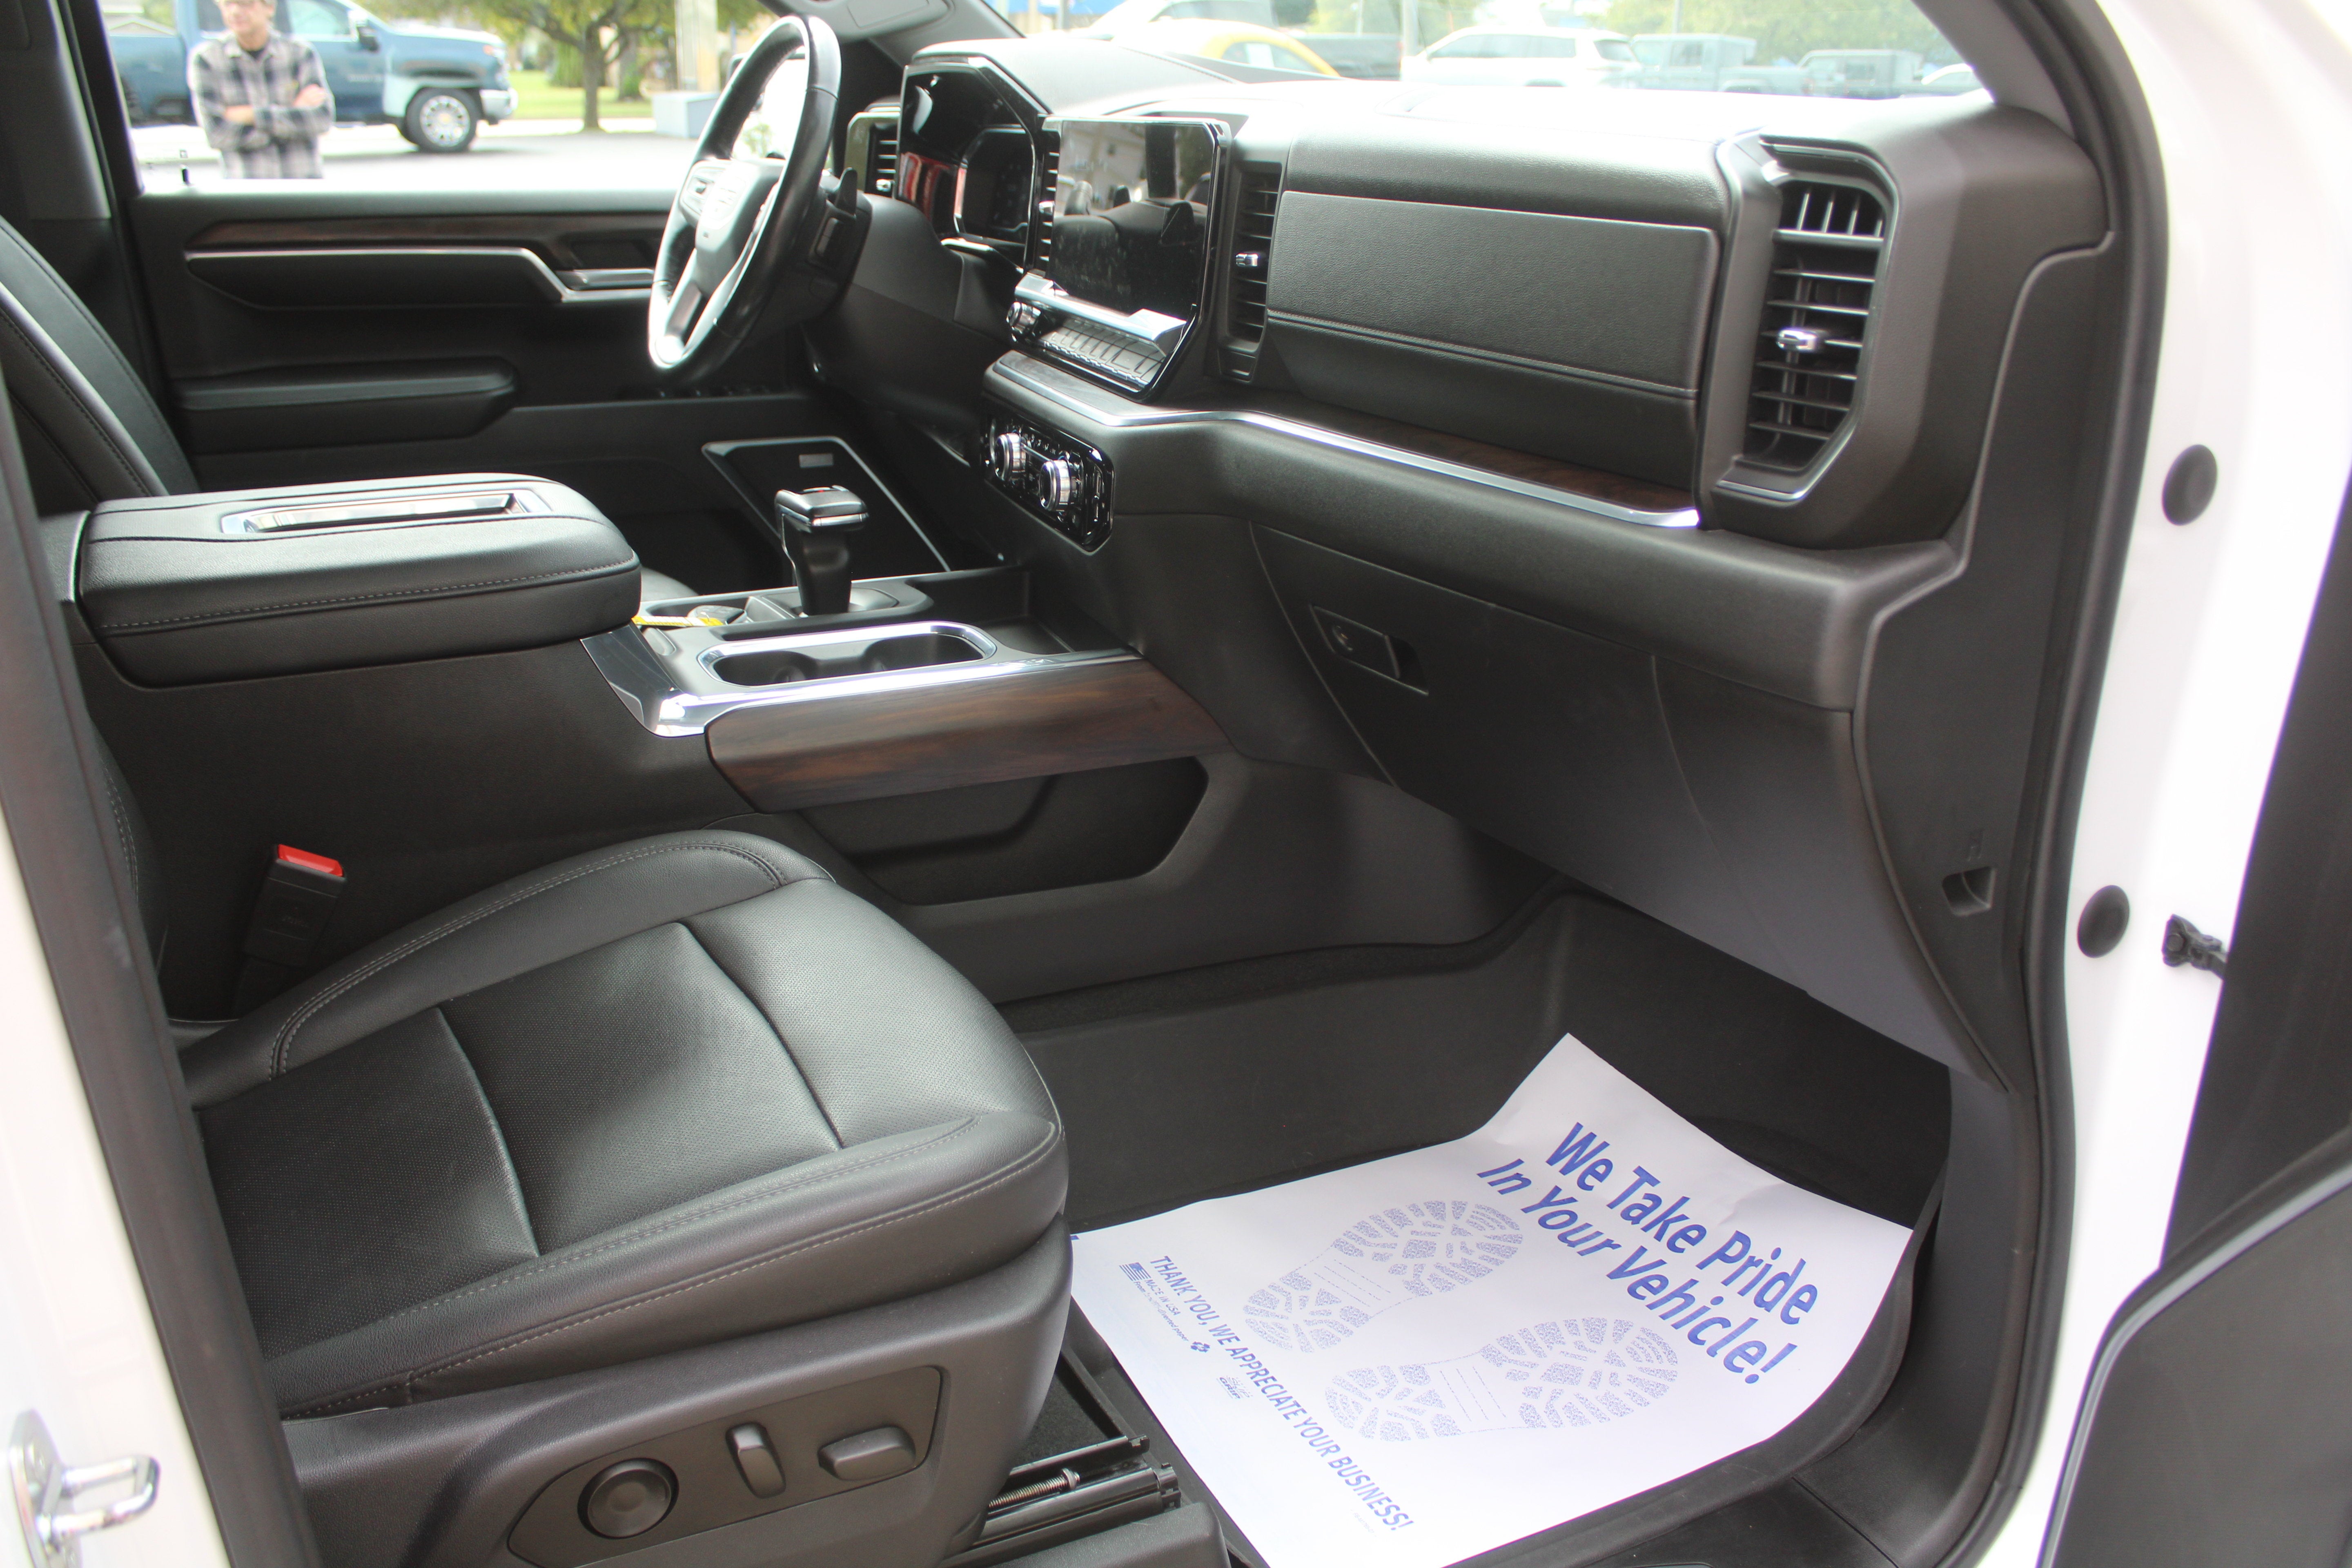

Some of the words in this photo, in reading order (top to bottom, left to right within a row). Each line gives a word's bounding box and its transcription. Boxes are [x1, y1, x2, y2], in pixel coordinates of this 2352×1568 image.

[1477, 1158, 1532, 1195] In
[1521, 1185, 1622, 1256] Your
[1606, 1245, 1797, 1384] Vehicle!
[1546, 1122, 1613, 1191] We
[1606, 1166, 1707, 1253] Take
[1696, 1230, 1818, 1325] Pride
[1133, 1281, 1146, 1292] From
[1172, 1328, 1189, 1341] paper
[1144, 1279, 1164, 1295] MADE
[1166, 1303, 1181, 1315] USA
[1150, 1256, 1197, 1296] THANK
[1184, 1294, 1220, 1325] YOU,
[1208, 1324, 1241, 1345] WE
[1225, 1347, 1307, 1420] APPRECIATE
[1293, 1417, 1341, 1457] YOUR
[1327, 1456, 1414, 1530] BUSINESS!
[1219, 1377, 1241, 1399] GRIP
